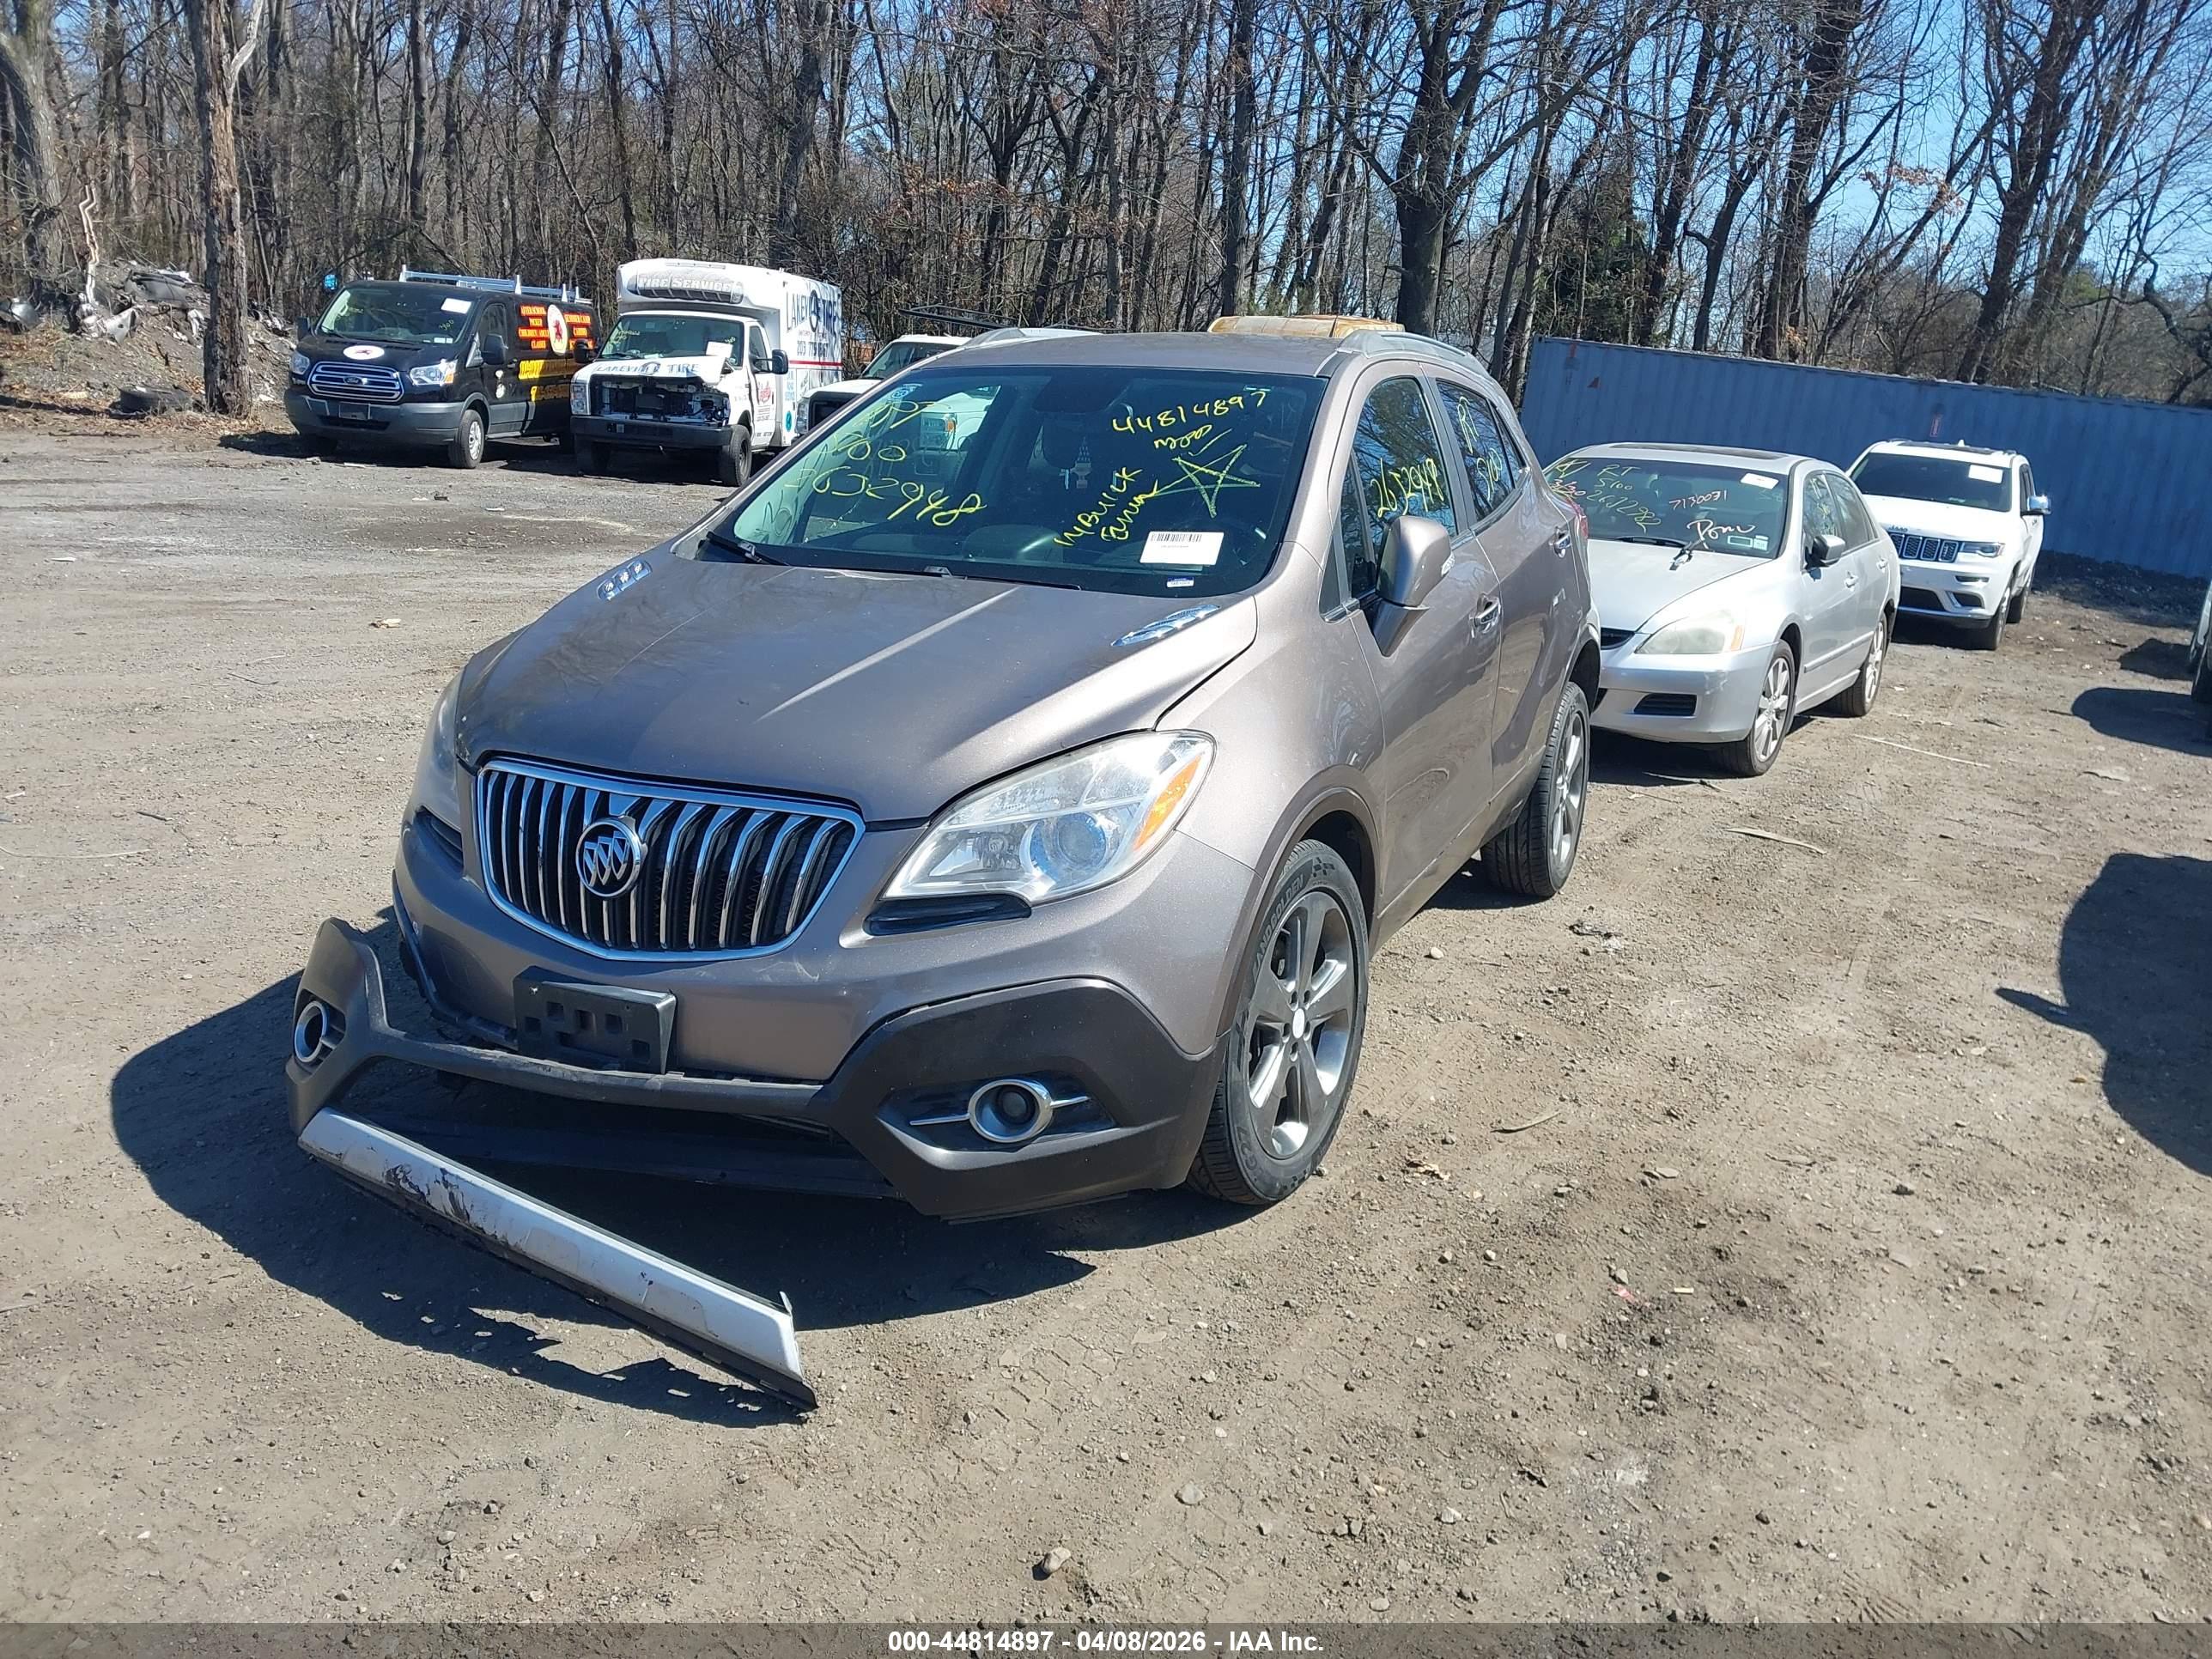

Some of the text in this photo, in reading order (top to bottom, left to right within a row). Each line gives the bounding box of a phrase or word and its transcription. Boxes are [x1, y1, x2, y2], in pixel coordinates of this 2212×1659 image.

[638, 276, 731, 292] TIRE SERVICE
[667, 363, 699, 373] TIRE
[1113, 391, 1267, 434] 44814897
